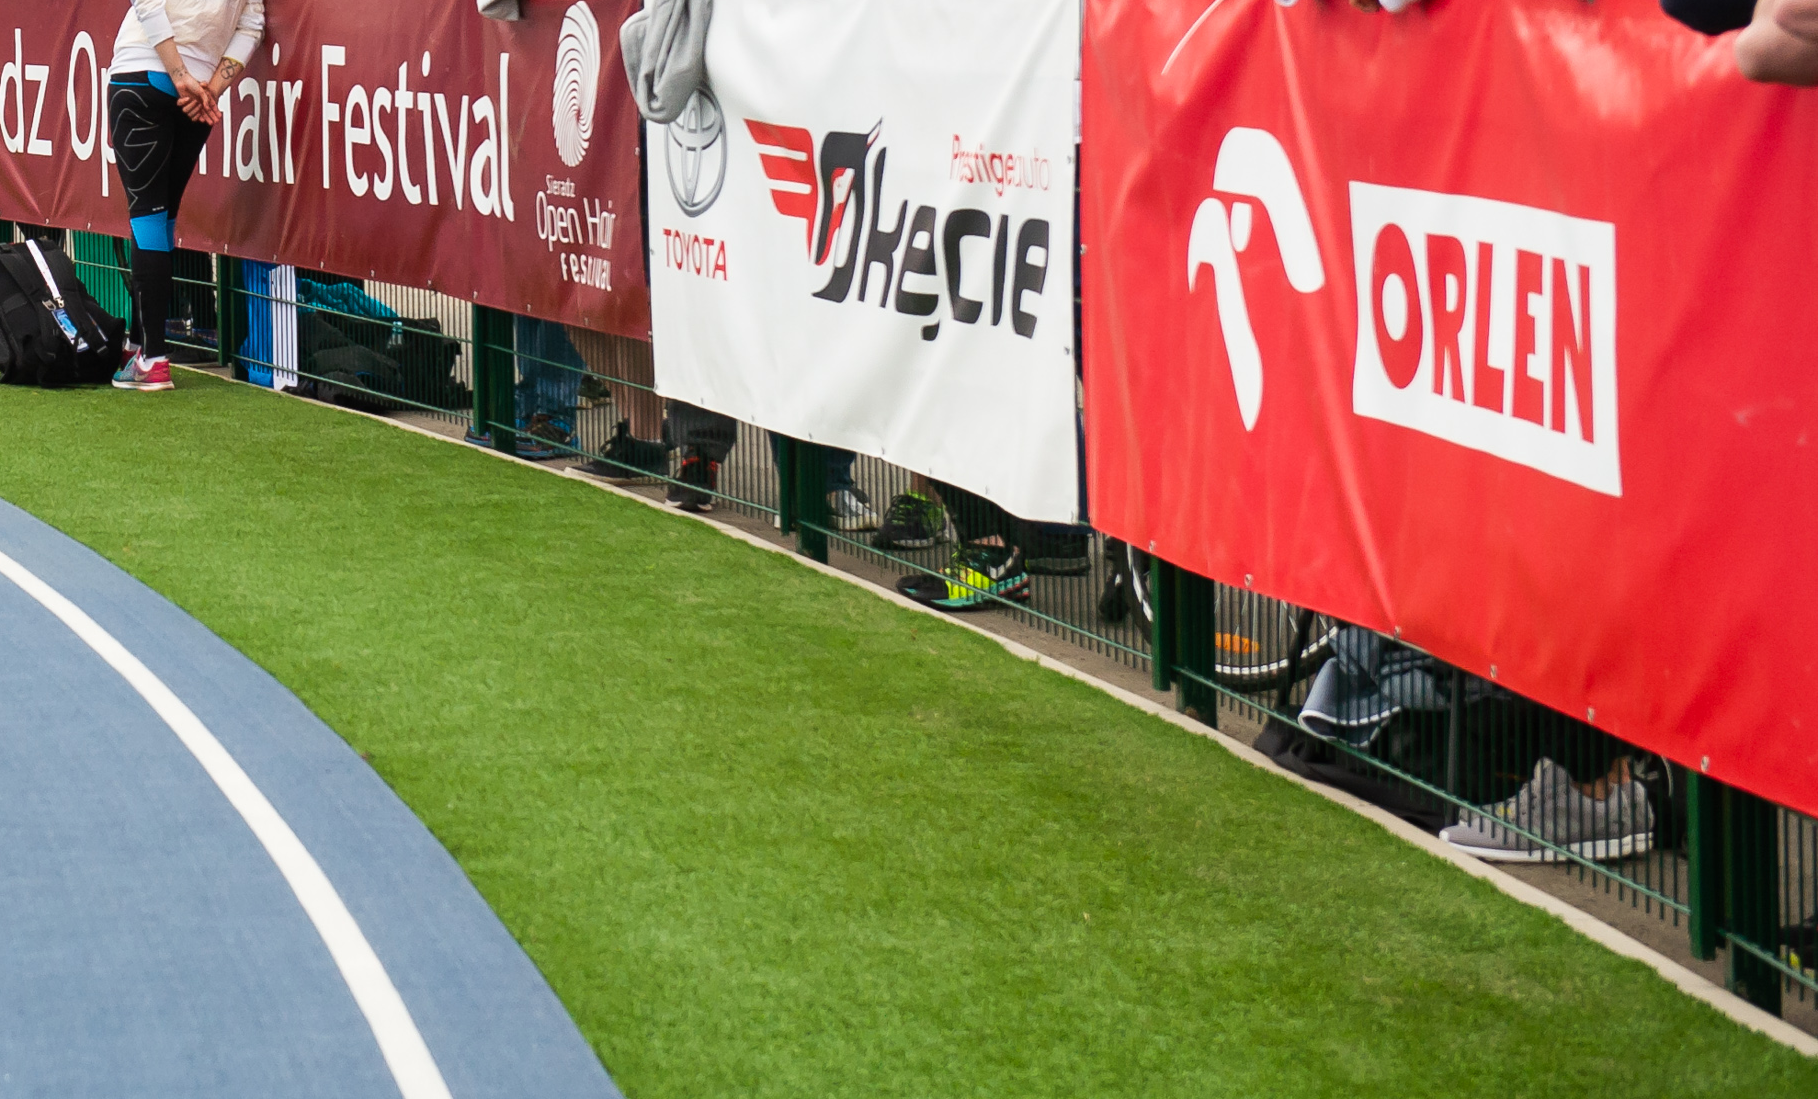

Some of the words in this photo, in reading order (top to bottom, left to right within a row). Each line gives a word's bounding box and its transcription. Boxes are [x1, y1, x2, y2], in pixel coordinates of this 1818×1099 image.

[67, 30, 117, 197] Op
[319, 43, 516, 223] Festival
[545, 174, 576, 198] Sieradz
[535, 190, 584, 252] Open
[583, 197, 617, 250] Hair
[663, 226, 728, 282] TOYOTA
[1371, 221, 1596, 446] ORLEN
